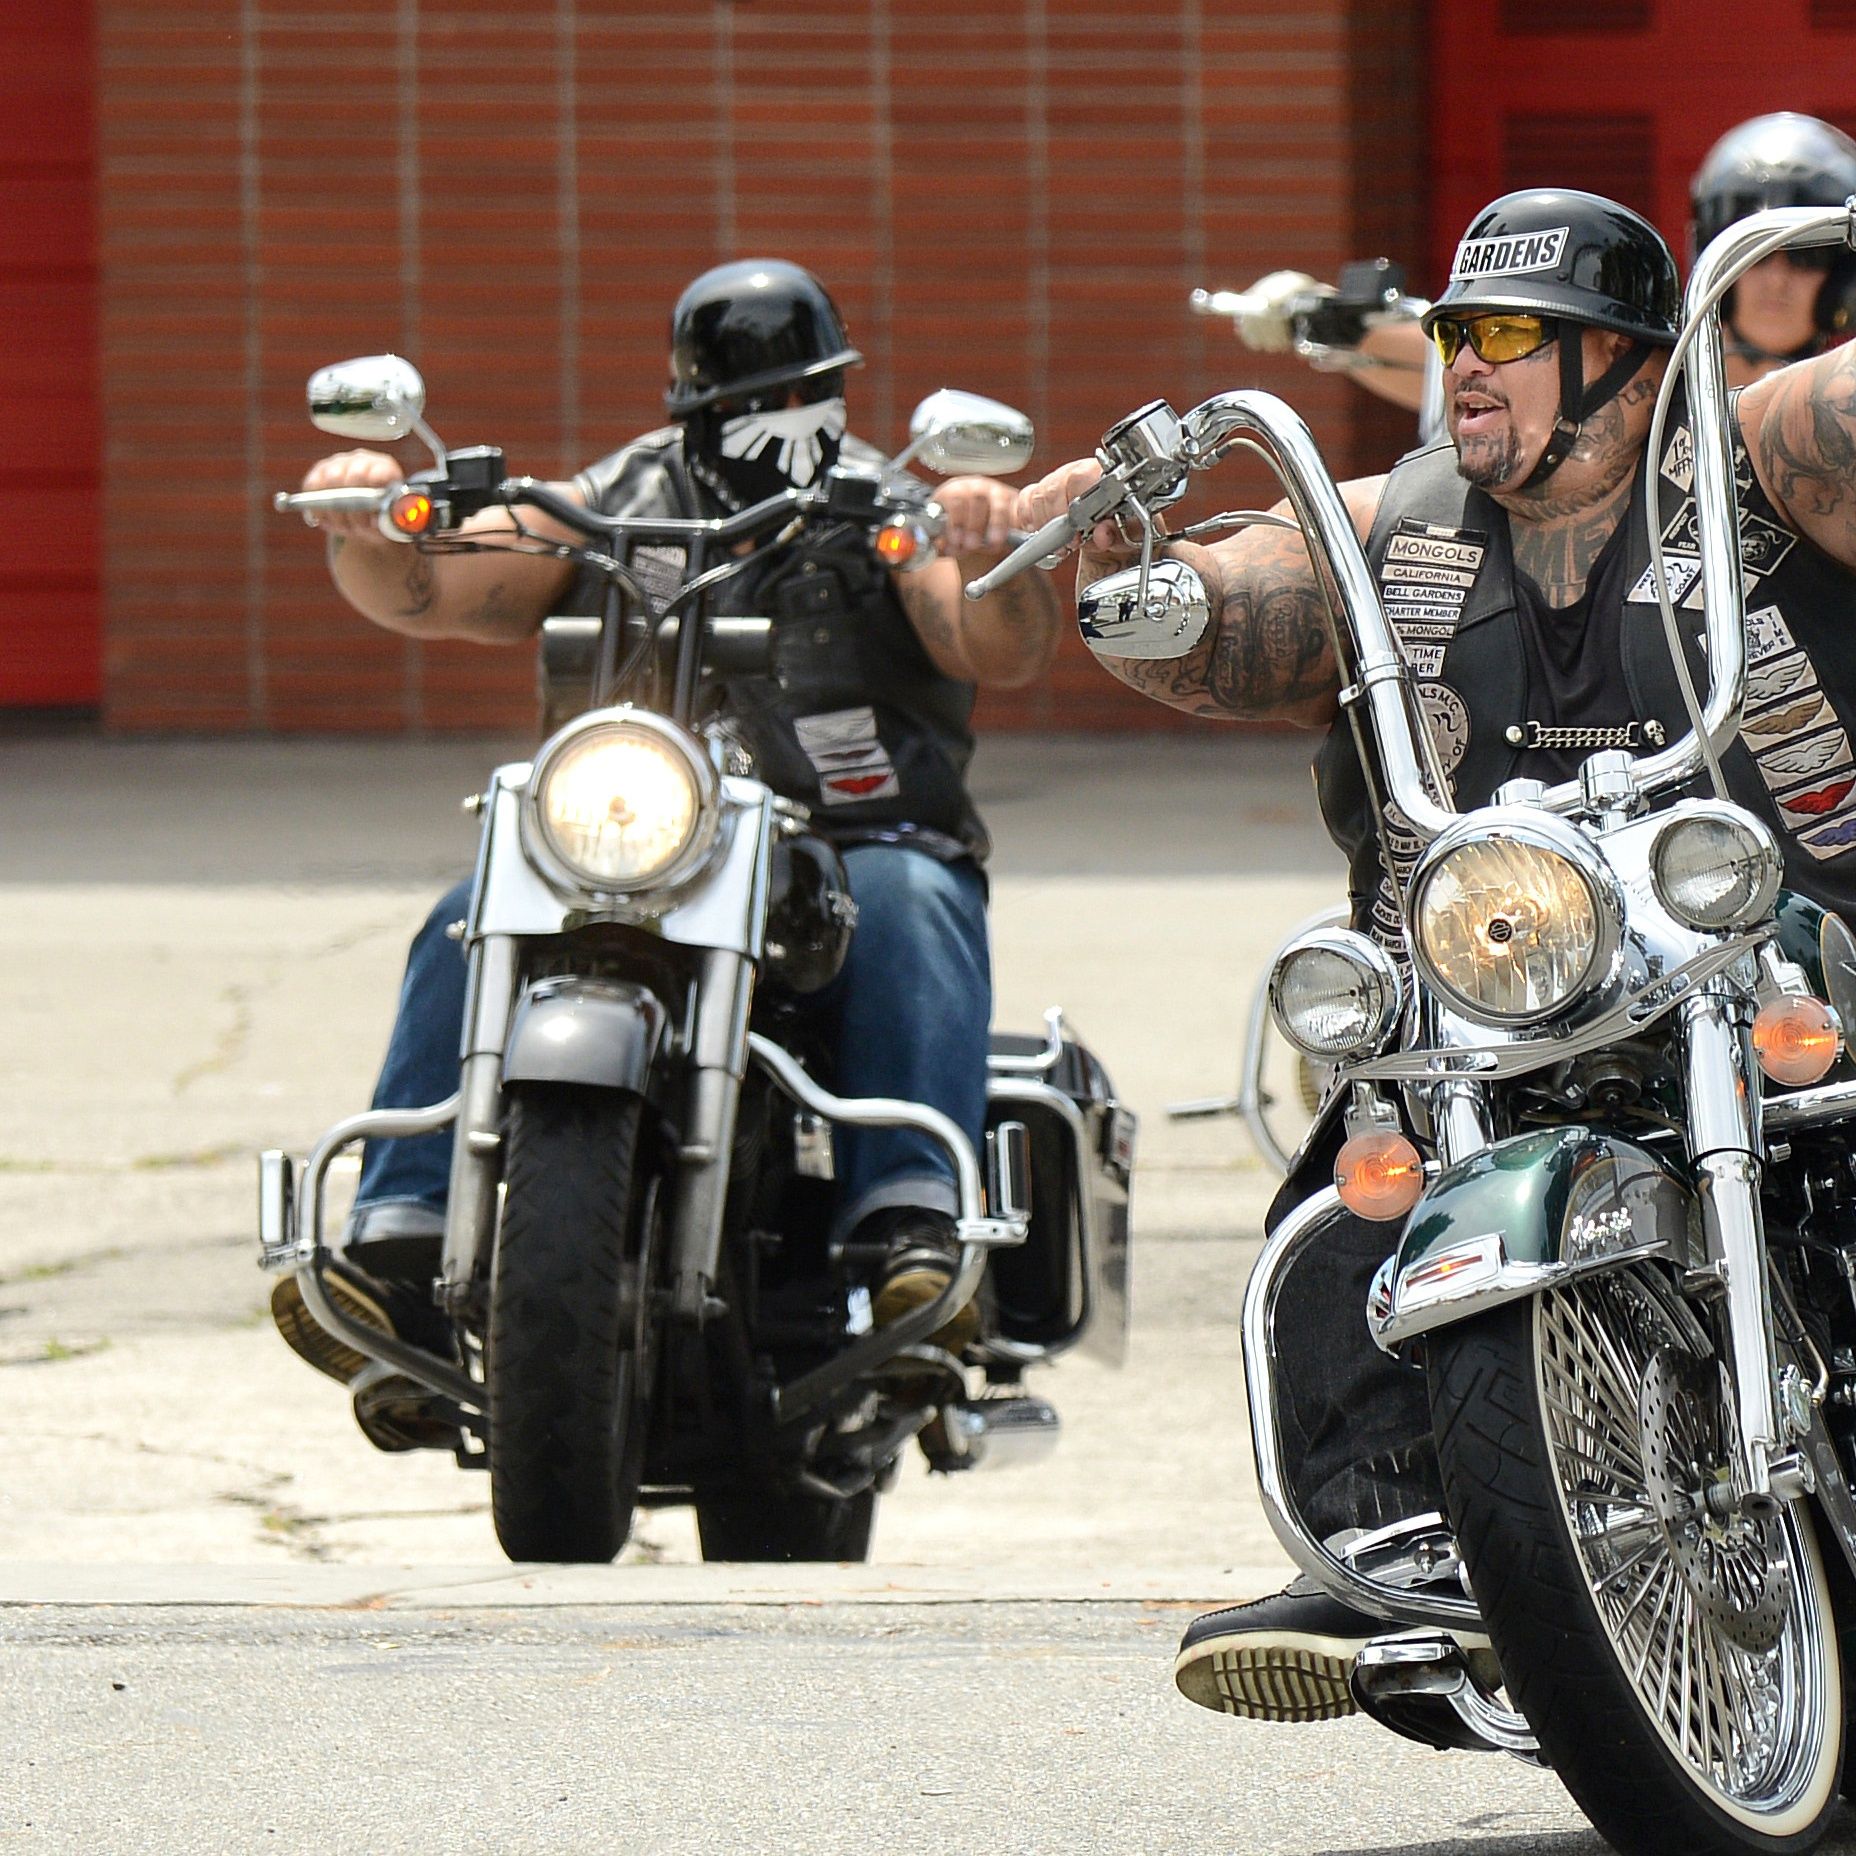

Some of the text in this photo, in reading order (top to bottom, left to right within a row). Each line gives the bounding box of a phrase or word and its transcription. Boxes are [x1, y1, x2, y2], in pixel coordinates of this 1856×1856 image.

[1459, 234, 1560, 274] GARDENS
[1392, 541, 1478, 563] MONGOLS
[1393, 568, 1461, 583] CALIFORNIA
[1675, 567, 1696, 595] COAST
[1385, 587, 1462, 601] BELL GARDENS
[1423, 607, 1459, 618] MEMBER
[1407, 625, 1453, 636] MONGOL
[1766, 611, 1788, 646] TIME
[1413, 648, 1442, 659] TIME
